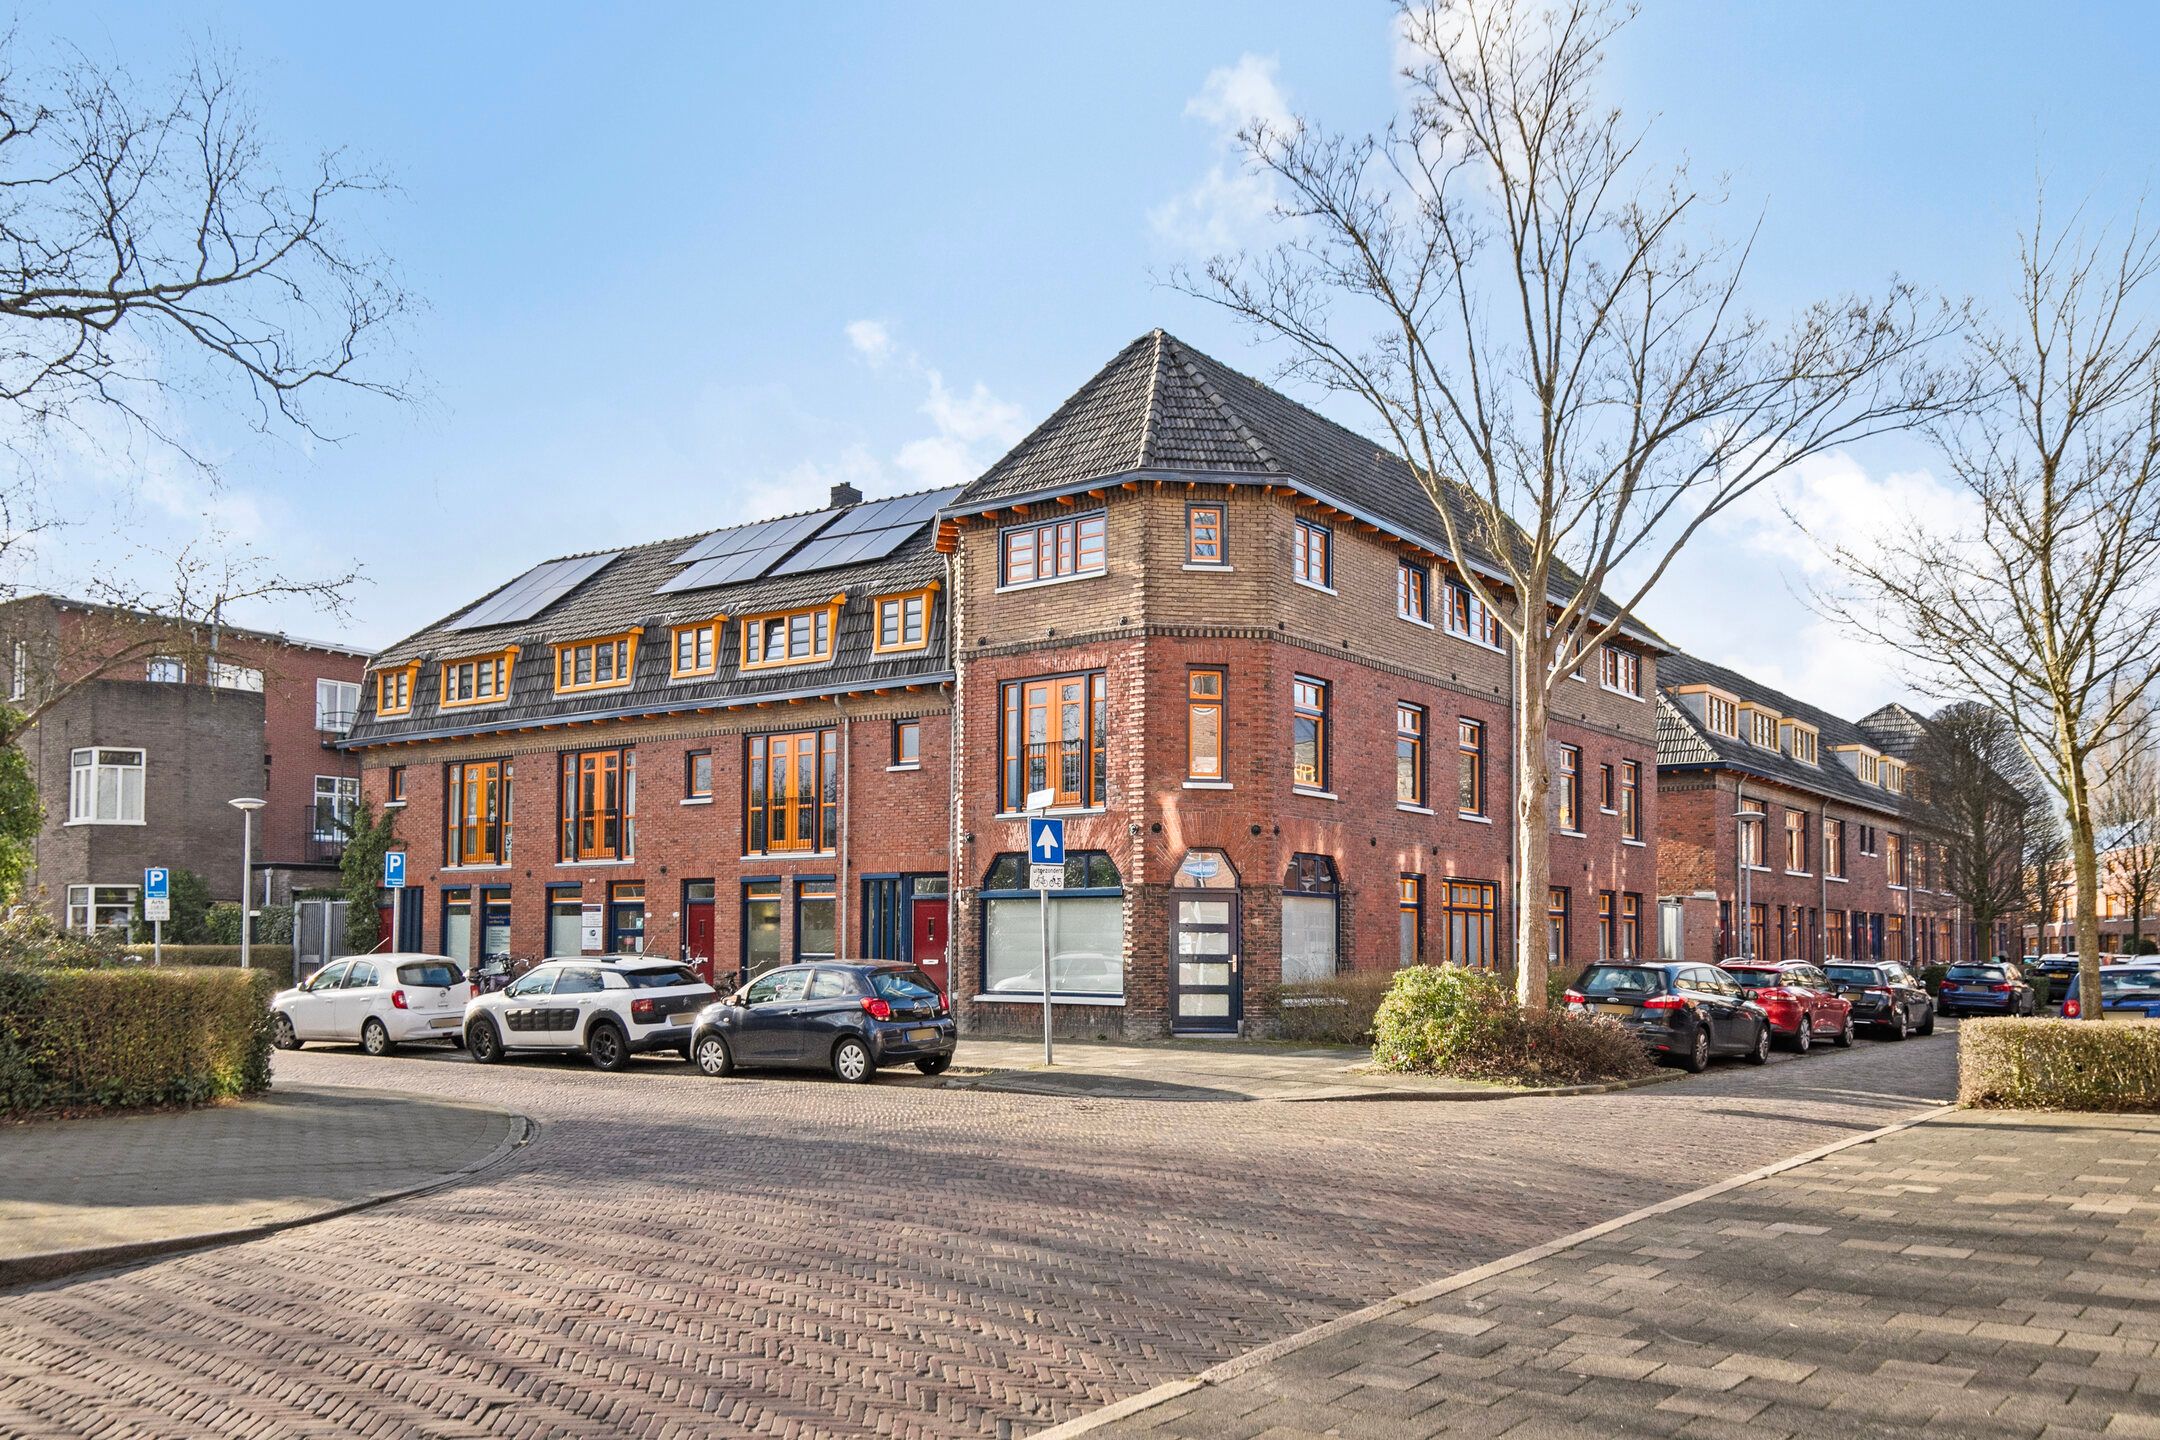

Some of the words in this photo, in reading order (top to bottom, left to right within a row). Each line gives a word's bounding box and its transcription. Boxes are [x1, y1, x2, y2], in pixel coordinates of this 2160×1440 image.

[390, 855, 401, 872] P
[1033, 867, 1063, 875] uitgezonderd
[151, 871, 163, 886] P
